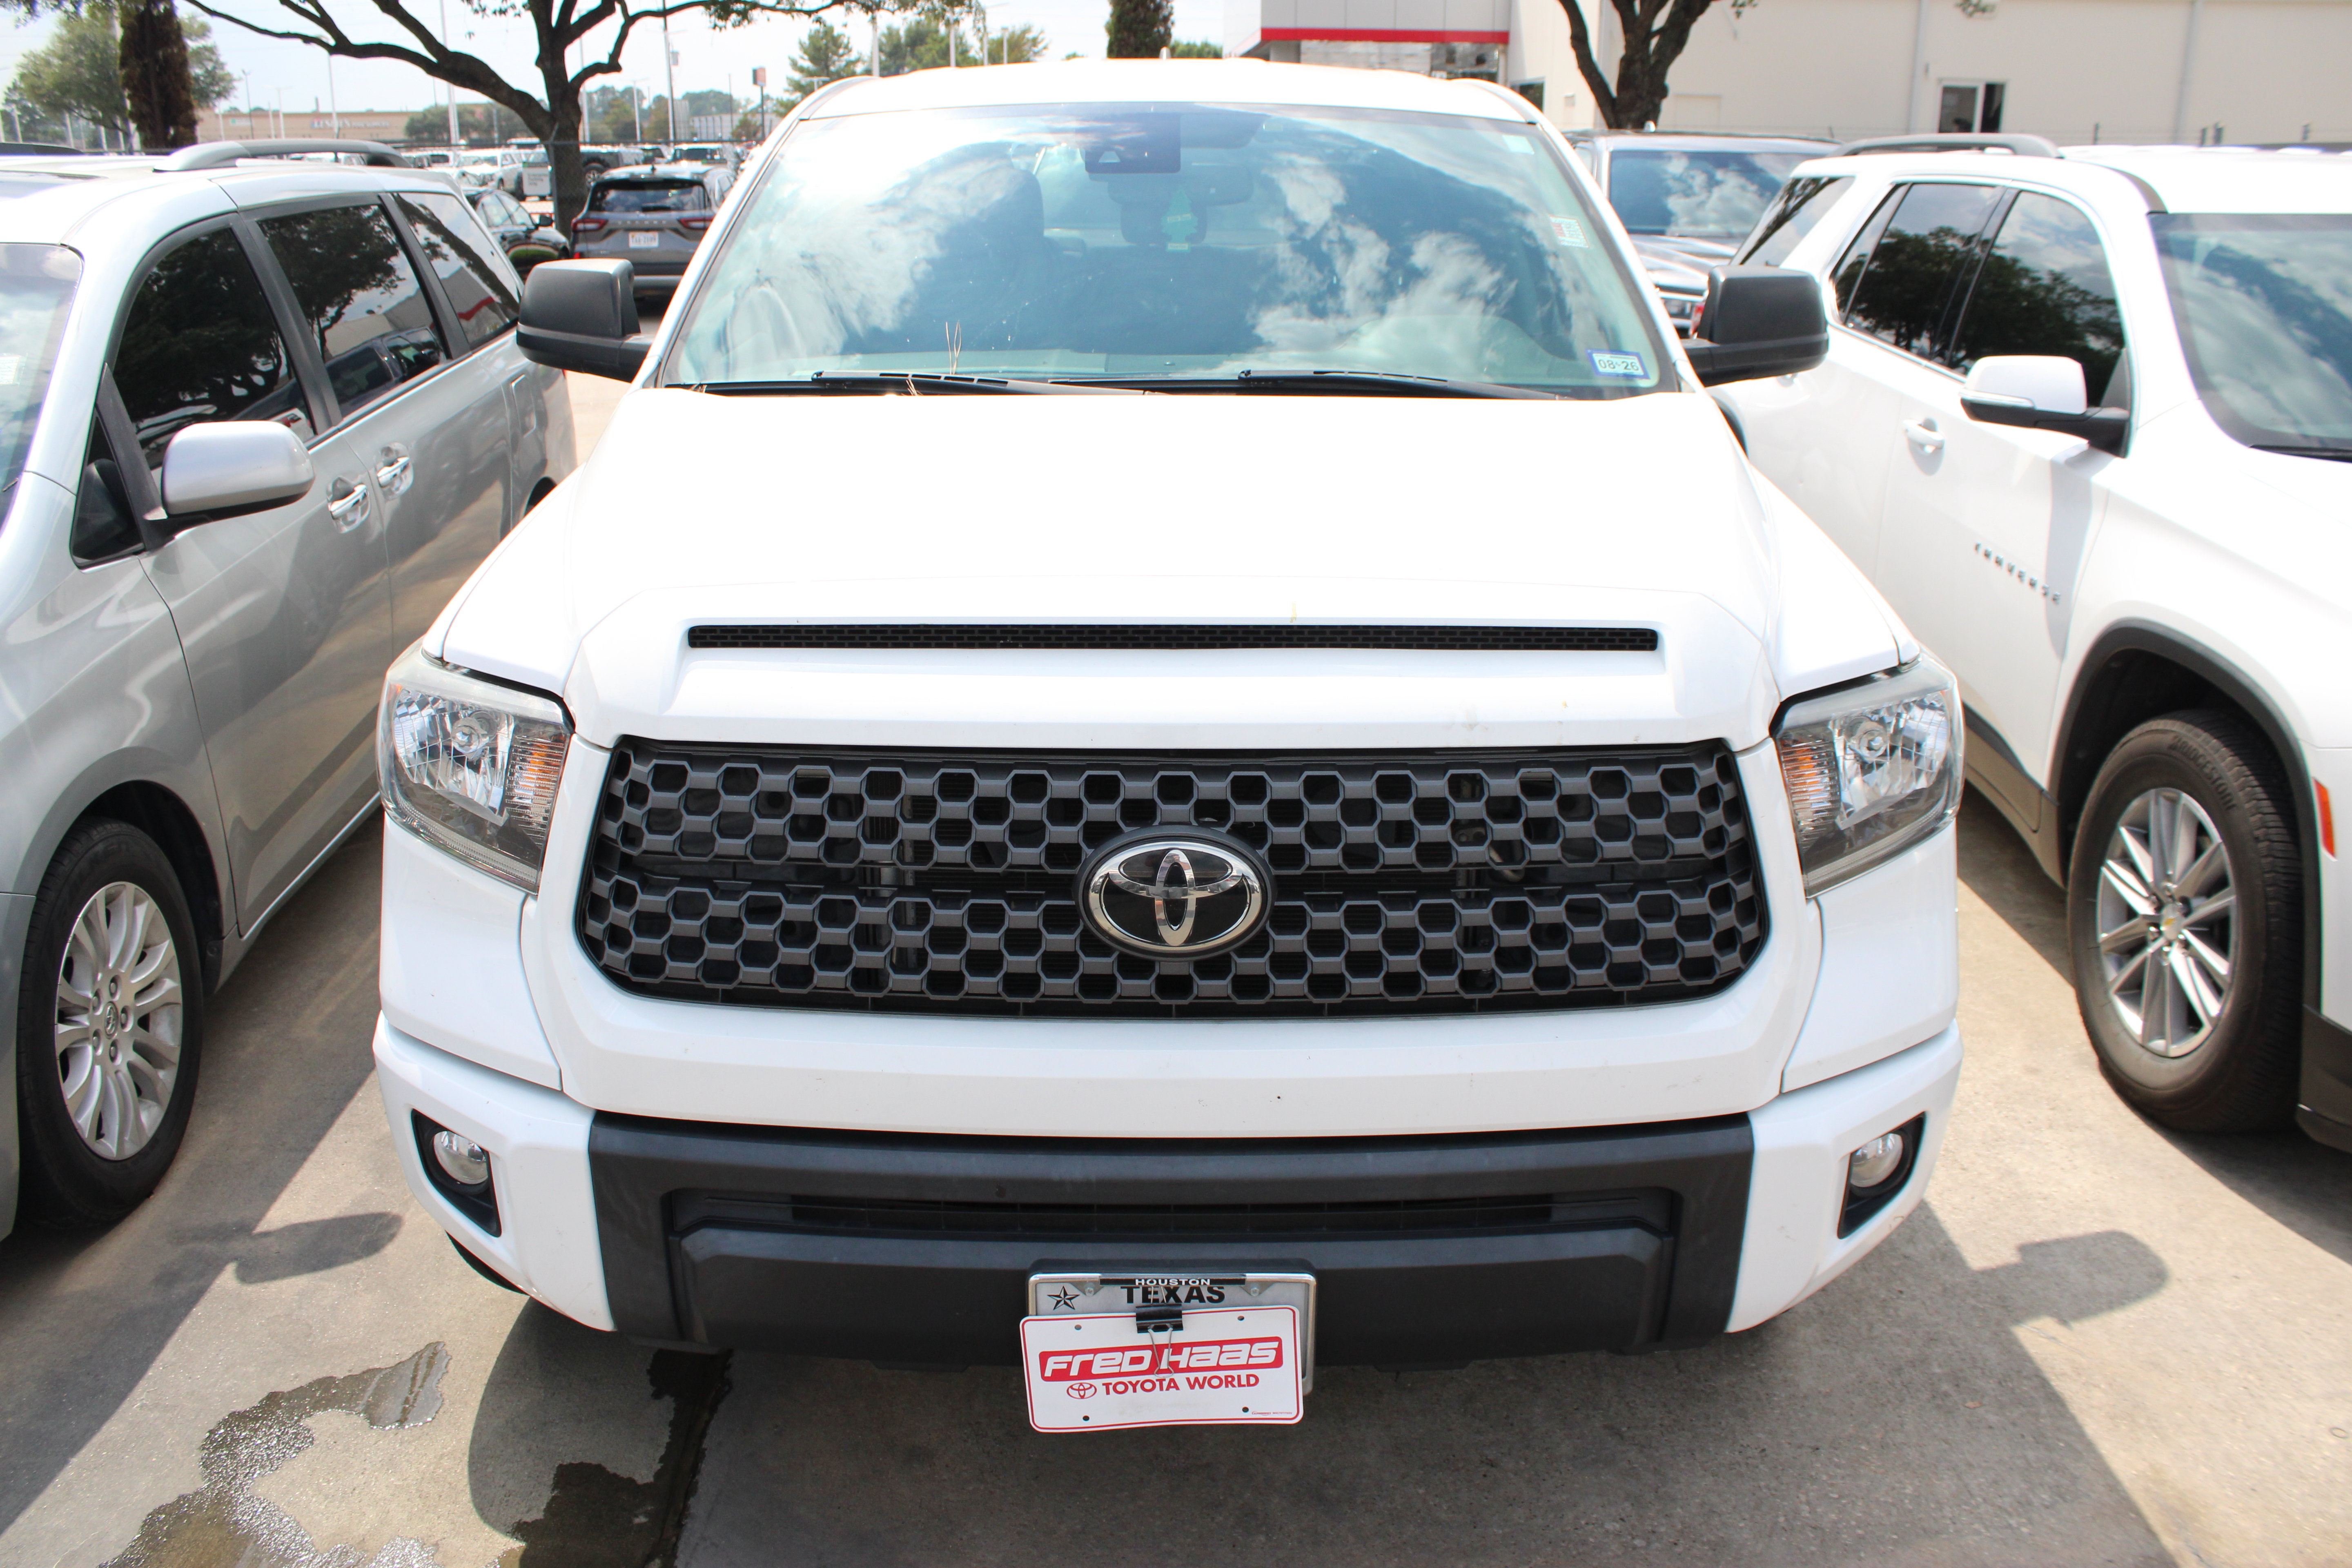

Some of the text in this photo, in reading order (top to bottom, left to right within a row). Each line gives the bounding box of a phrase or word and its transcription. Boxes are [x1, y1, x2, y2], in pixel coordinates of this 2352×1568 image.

[1120, 1286, 1225, 1304] TEXAS
[1102, 1373, 1260, 1395] TOYOTA WORLD
